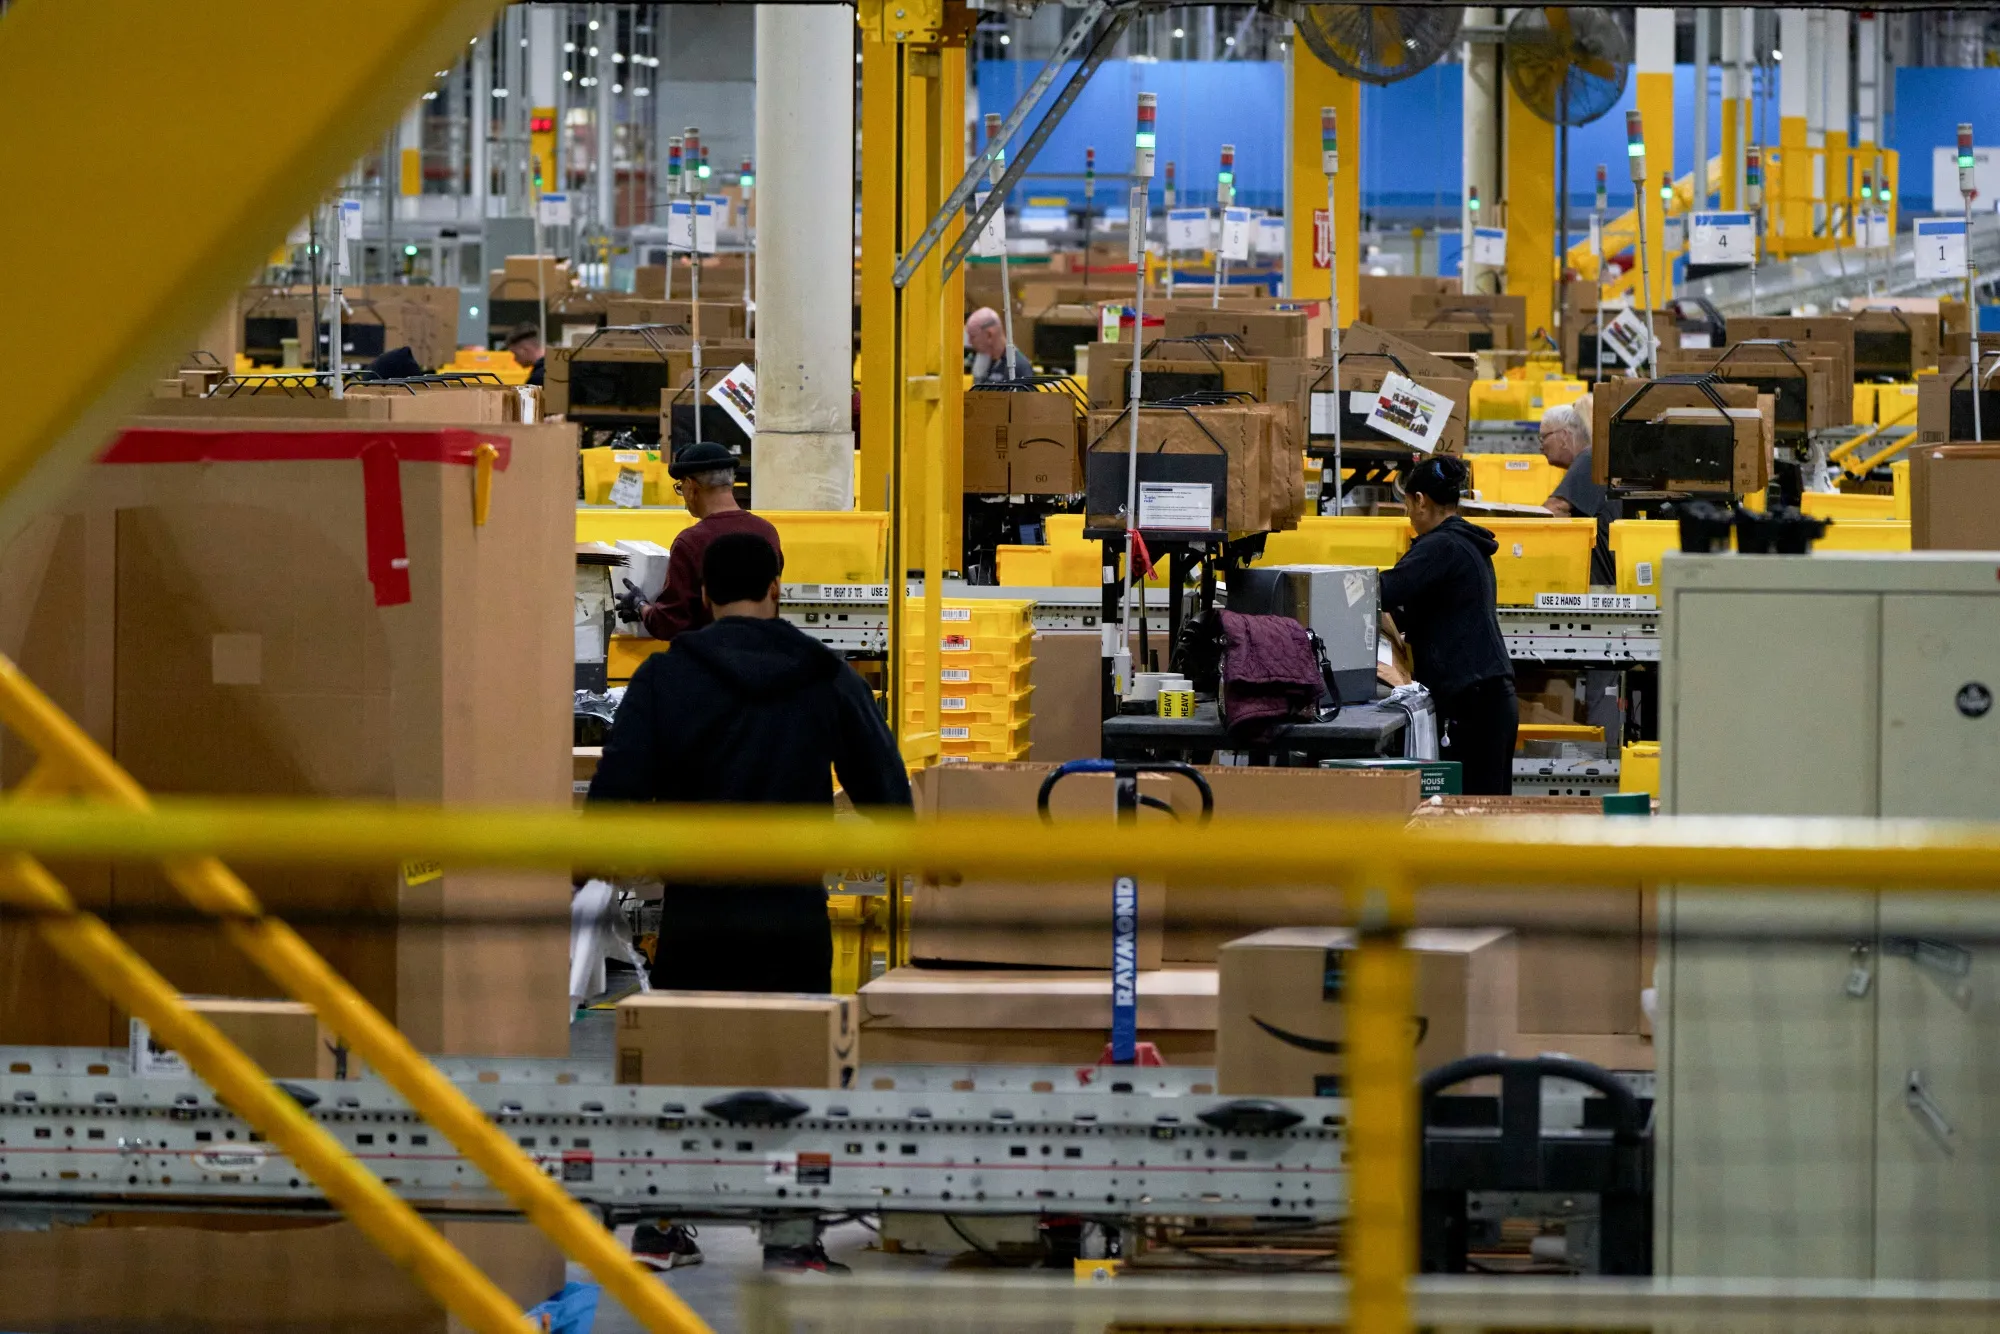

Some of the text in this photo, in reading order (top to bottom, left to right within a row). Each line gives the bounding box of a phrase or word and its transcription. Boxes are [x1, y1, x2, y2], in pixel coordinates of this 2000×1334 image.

[1718, 235, 1728, 248] 4
[1938, 245, 1946, 261] 1
[1036, 474, 1048, 483] 60
[871, 587, 889, 597] USE 2
[1542, 596, 1581, 606] USE 2 HANDS
[1181, 693, 1189, 717] HEAVY
[1421, 777, 1445, 785] HOUSE
[1115, 877, 1134, 1006] RAYMOND
